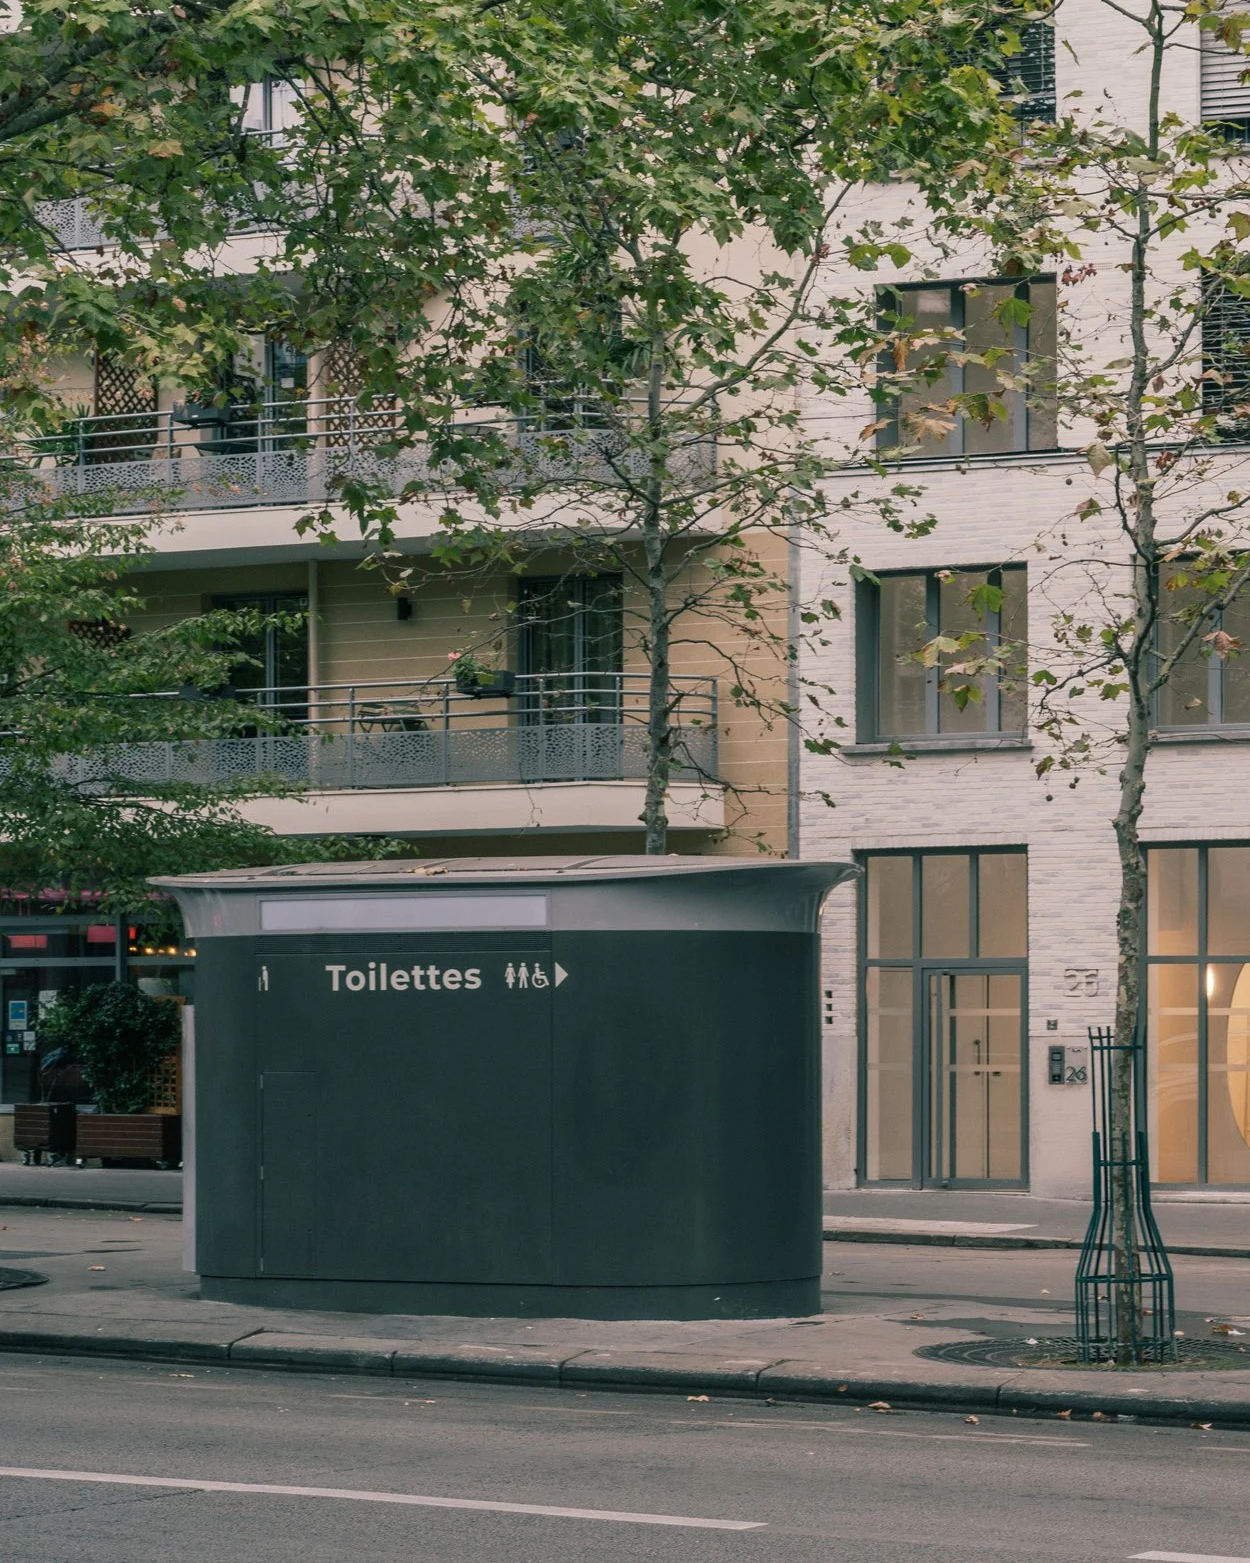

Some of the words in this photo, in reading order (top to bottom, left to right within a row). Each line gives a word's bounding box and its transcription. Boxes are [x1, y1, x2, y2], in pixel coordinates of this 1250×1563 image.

[325, 961, 482, 992] Toilettes
[1064, 968, 1100, 997] 26
[1066, 1065, 1087, 1082] 26
